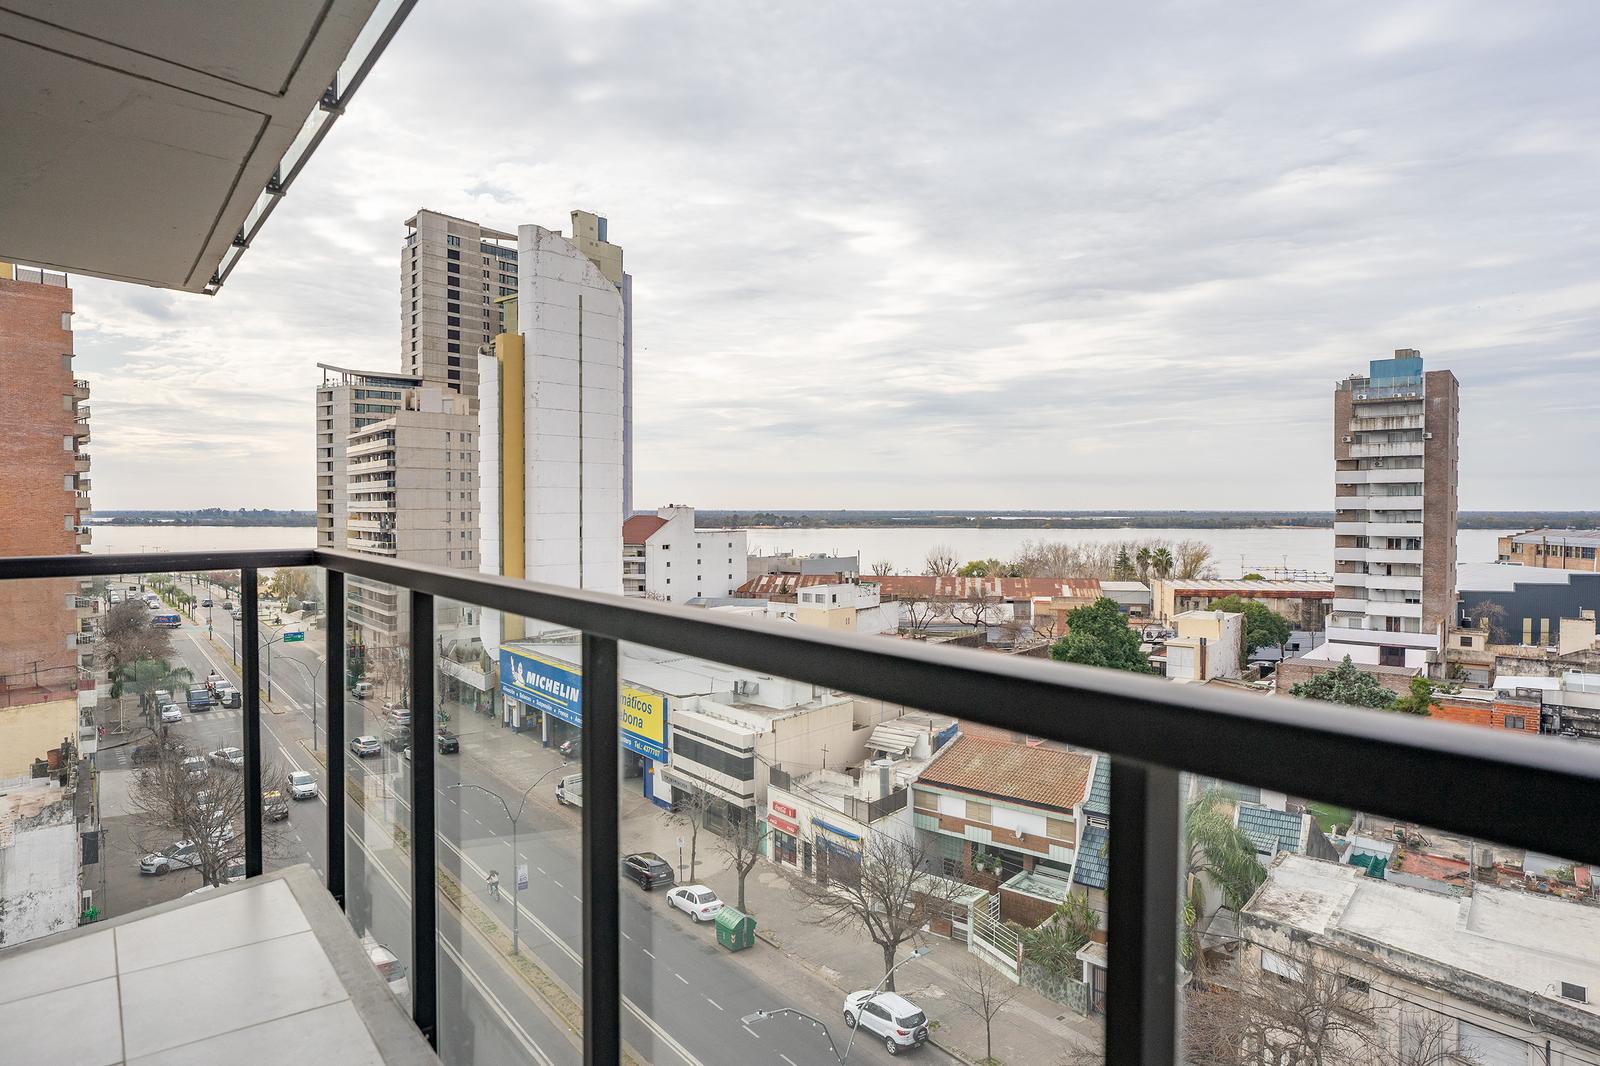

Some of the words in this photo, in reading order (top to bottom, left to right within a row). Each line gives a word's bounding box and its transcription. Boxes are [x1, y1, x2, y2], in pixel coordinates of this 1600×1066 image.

[526, 671, 580, 703] MICHELIN
[619, 693, 653, 715] máticos
[621, 708, 644, 729] bona
